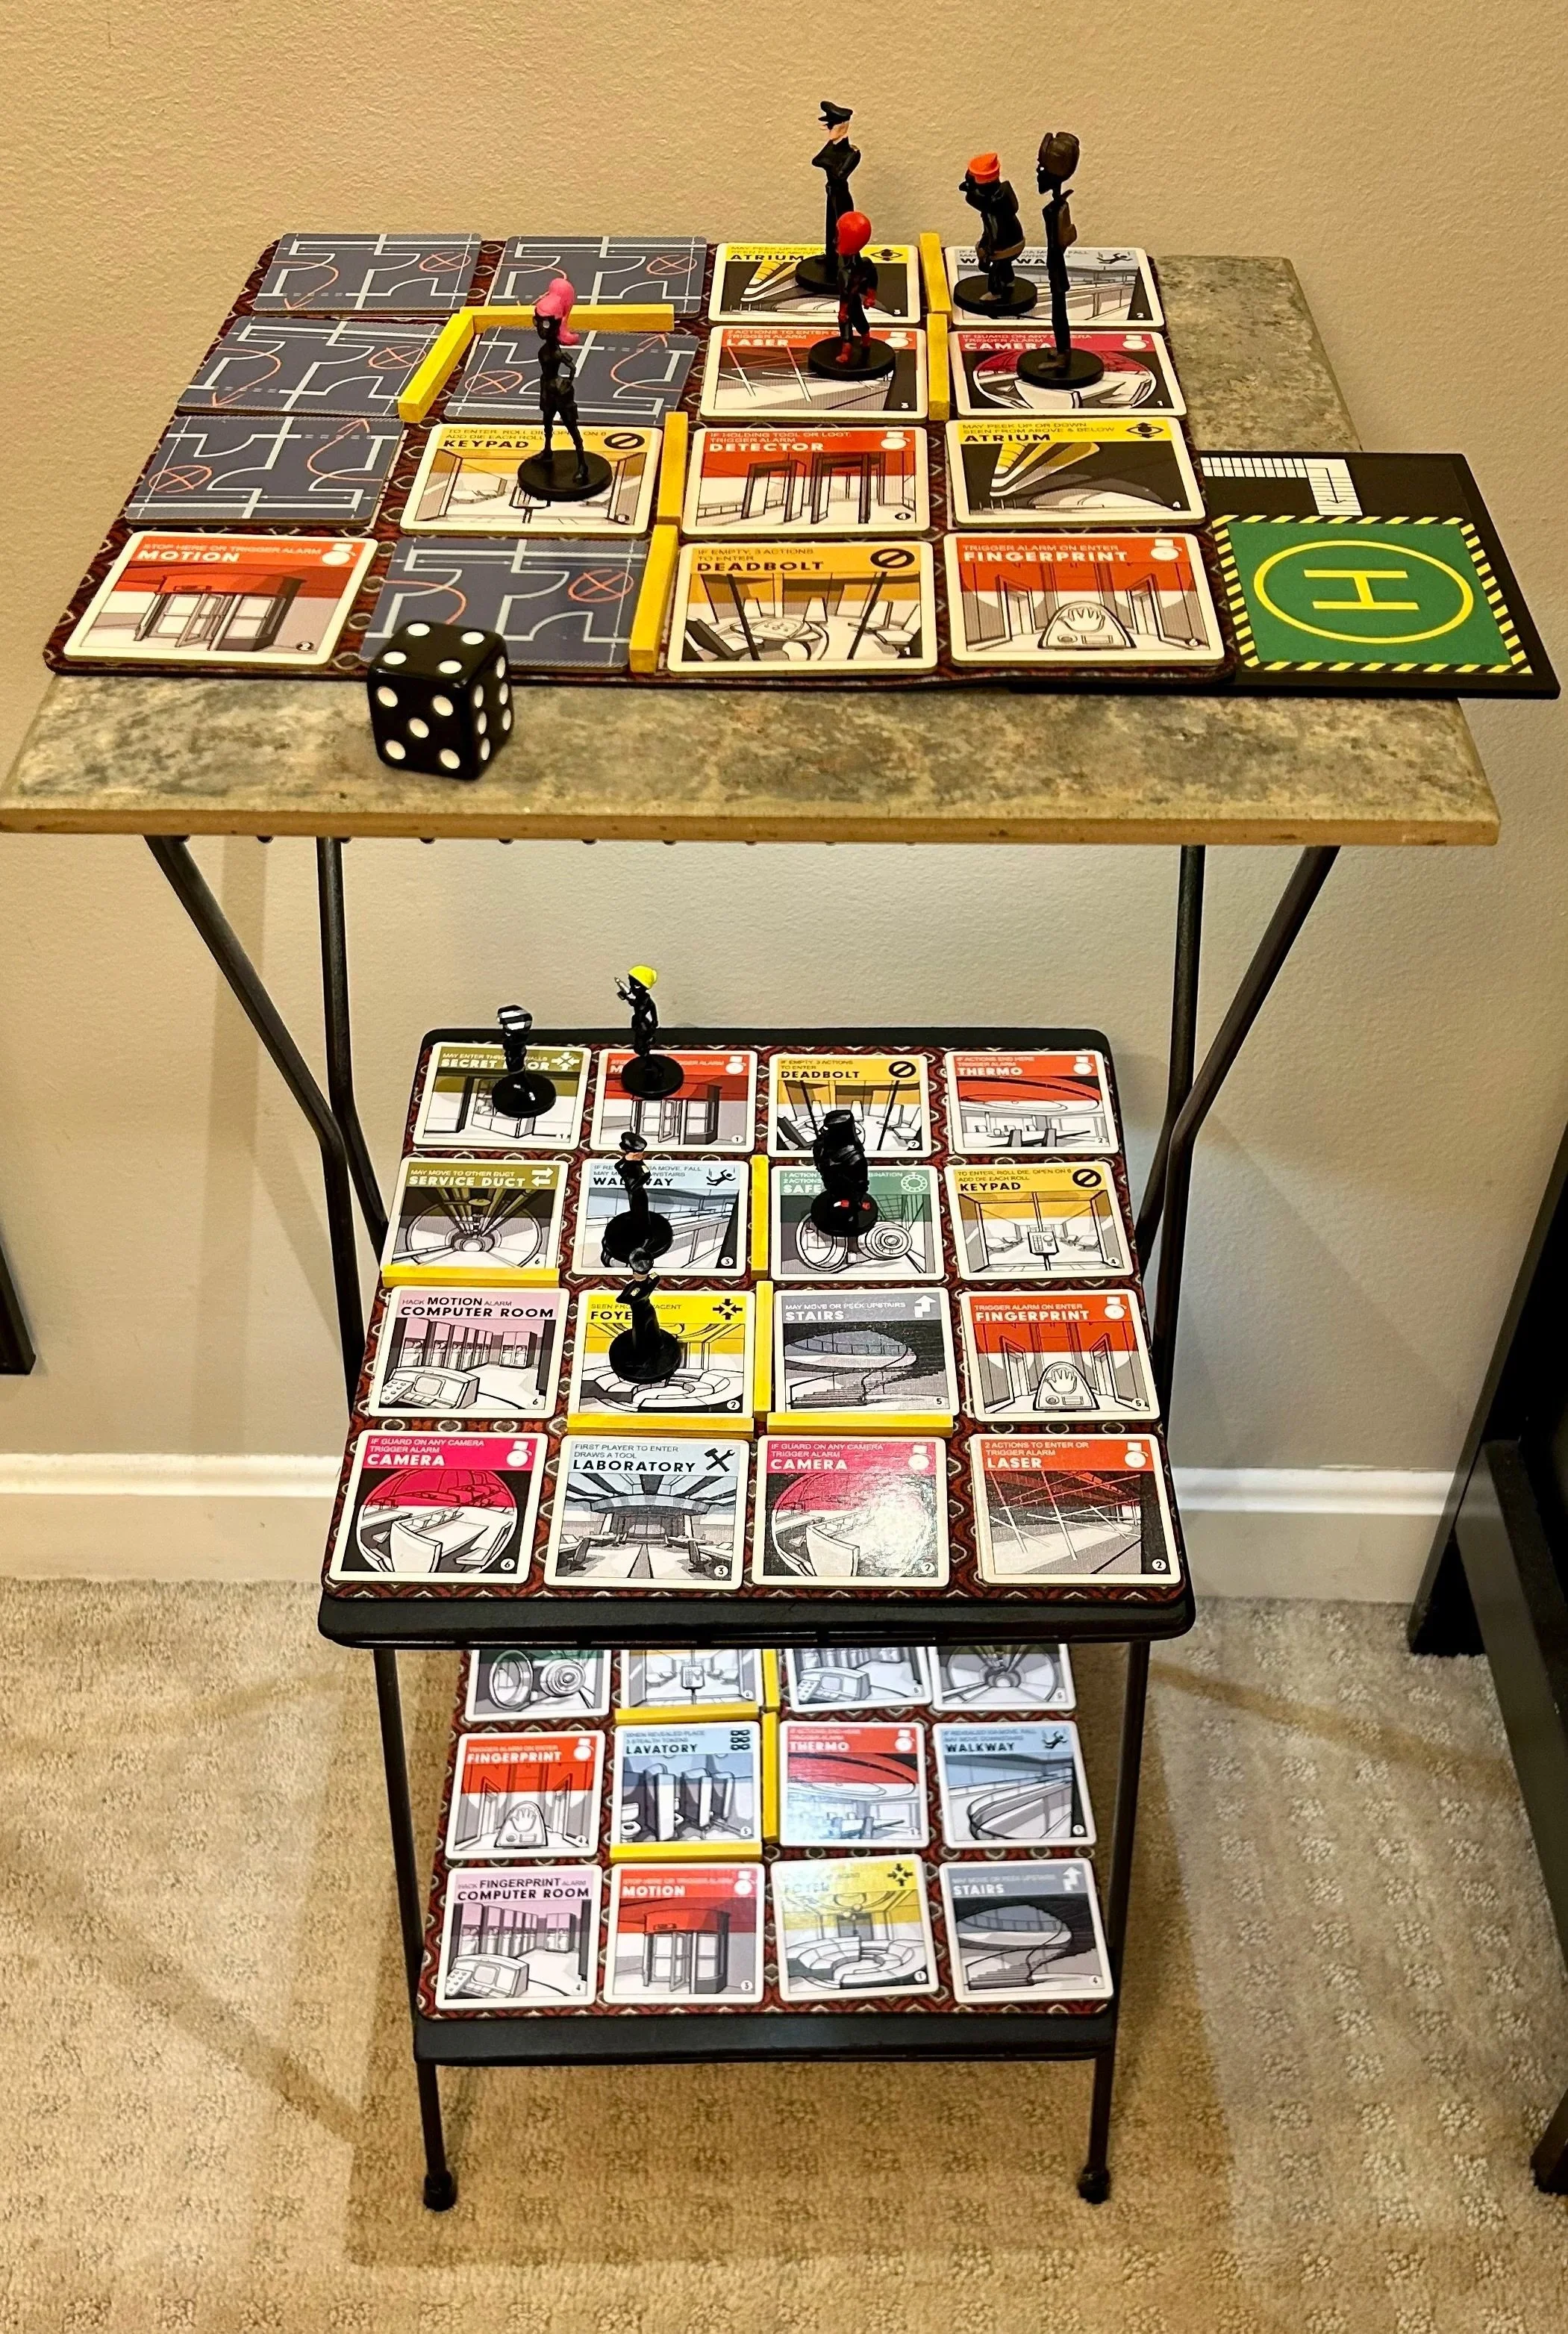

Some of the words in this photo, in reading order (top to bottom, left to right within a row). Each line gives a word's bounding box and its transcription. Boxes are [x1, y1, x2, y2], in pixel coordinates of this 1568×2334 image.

[725, 338, 789, 347] LASER
[963, 434, 1051, 443] ATRIUM
[443, 440, 530, 449] KEYPAD
[709, 443, 824, 452] DETECTOR
[137, 549, 240, 563] MOTION
[963, 551, 1128, 562] FINGERPRINT
[697, 561, 824, 572] DEADBOLT
[440, 1059, 498, 1069] SECRET
[781, 1070, 860, 1079] DEADBOLT
[957, 1067, 1023, 1076] THERMO
[409, 1176, 475, 1186] SERVICE
[481, 1178, 527, 1188] DUCT
[960, 1182, 1022, 1192] KEYPAD
[784, 1184, 822, 1194] SAFE
[427, 1297, 484, 1306] MOTION
[400, 1306, 493, 1317] COMPUTER
[499, 1308, 554, 1318] ROOM
[590, 1311, 633, 1320] FOYE
[785, 1310, 845, 1321] STAIRS
[975, 1310, 1089, 1322] FINGERPRINT
[366, 1453, 446, 1467] CAMERA
[769, 1458, 848, 1470] CAMERA
[987, 1457, 1043, 1469] LASER
[572, 1459, 696, 1473] LABORATORY
[1156, 1560, 1162, 1569] 2
[625, 1743, 698, 1755] LAVATORY
[789, 1741, 851, 1752] THERMO
[946, 1742, 1015, 1753] WALKWAY
[466, 1751, 563, 1764] FINGERPRINT
[479, 1877, 562, 1889] FINGERPRINT
[457, 1890, 537, 1901] COMPUTER
[543, 1887, 590, 1899] ROOM
[621, 1885, 687, 1899] MOTION
[952, 1884, 1005, 1896] STAIRS
